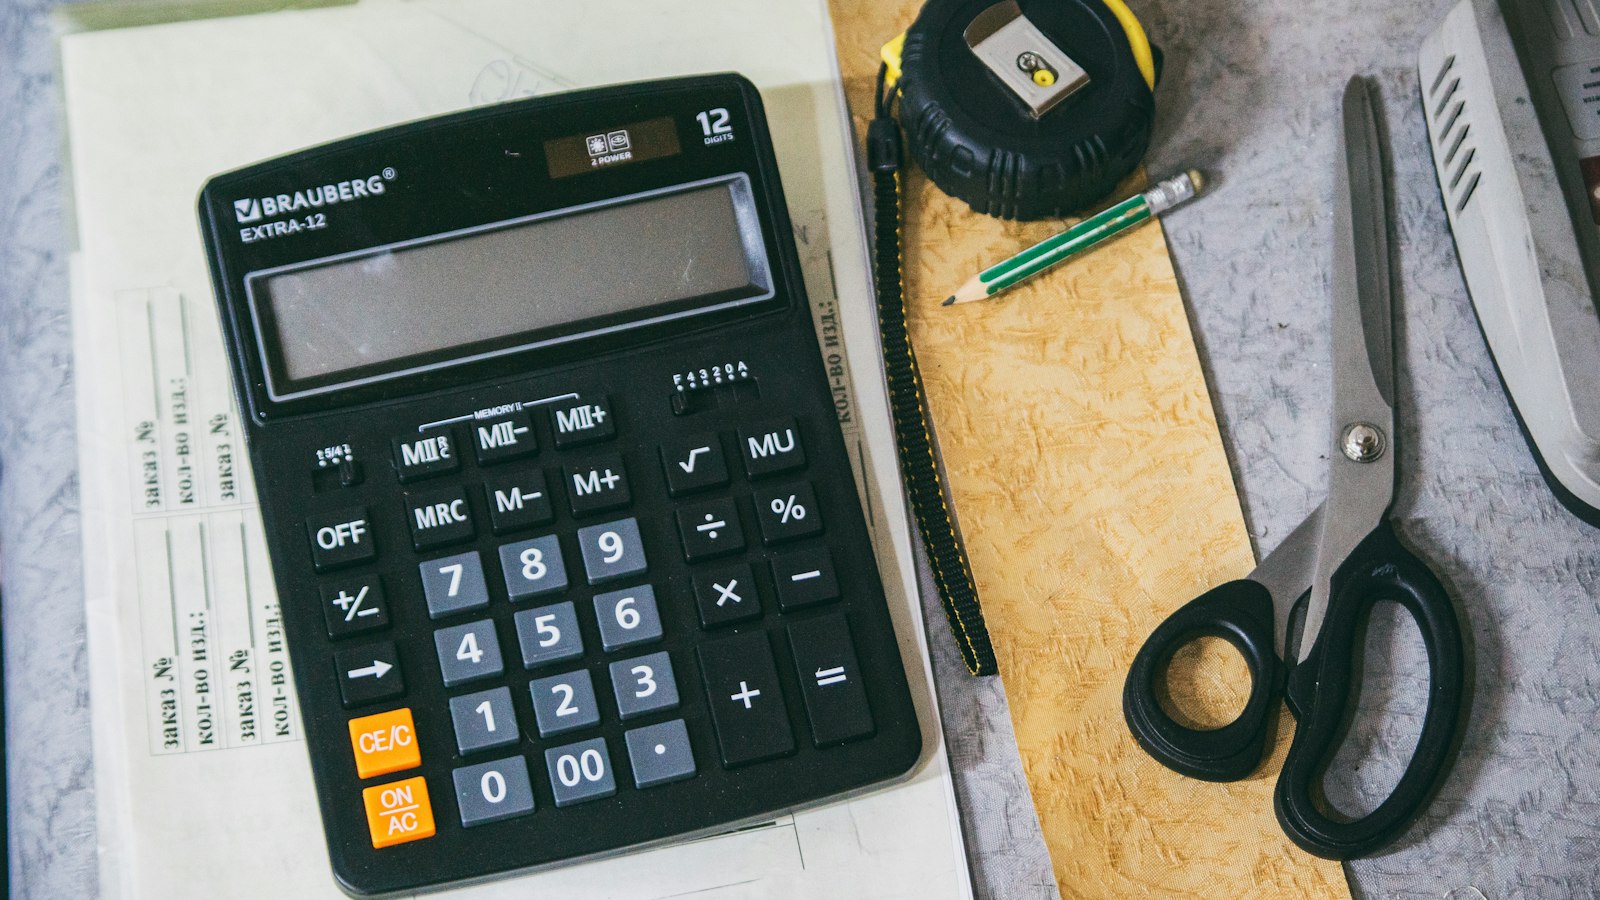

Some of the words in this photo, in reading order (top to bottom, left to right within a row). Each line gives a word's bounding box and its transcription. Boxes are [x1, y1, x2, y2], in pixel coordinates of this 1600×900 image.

[696, 108, 732, 136] 12
[704, 132, 733, 144] DIGITS
[591, 158, 598, 166] 2
[600, 151, 632, 163] POWER
[239, 212, 327, 243] EXTRA-12
[673, 374, 682, 385] F
[687, 371, 695, 381] 4
[699, 369, 709, 379] 3
[712, 366, 721, 377] 2
[738, 361, 748, 372] A
[209, 413, 229, 436] №
[474, 404, 512, 420] MEMORY
[135, 421, 155, 443] №
[748, 429, 794, 458] MU
[145, 450, 160, 508] заказ
[175, 432, 194, 504] кол-во
[217, 444, 235, 501] заказ
[573, 469, 619, 495] M+
[415, 499, 466, 529] MRC
[771, 495, 805, 523] %
[317, 520, 365, 549] OFF
[599, 532, 623, 563] 9
[520, 548, 546, 579] 8
[439, 564, 462, 596] 7
[615, 598, 640, 629] 6
[190, 611, 208, 662] изд.:
[535, 614, 560, 647] 5
[229, 649, 250, 674] №
[457, 633, 483, 663] 4
[153, 657, 174, 681] №
[631, 666, 656, 697] 3
[194, 668, 214, 745] кол-во
[270, 660, 290, 737] кол-во
[552, 684, 578, 716] 2
[731, 681, 760, 708] +
[160, 688, 179, 749] заказ
[237, 680, 255, 742] заказ
[476, 701, 495, 731] 1
[359, 725, 412, 754] CE/C
[557, 749, 604, 786] 00
[380, 786, 412, 808] ON
[481, 771, 506, 803] 0
[388, 813, 418, 836] AC
